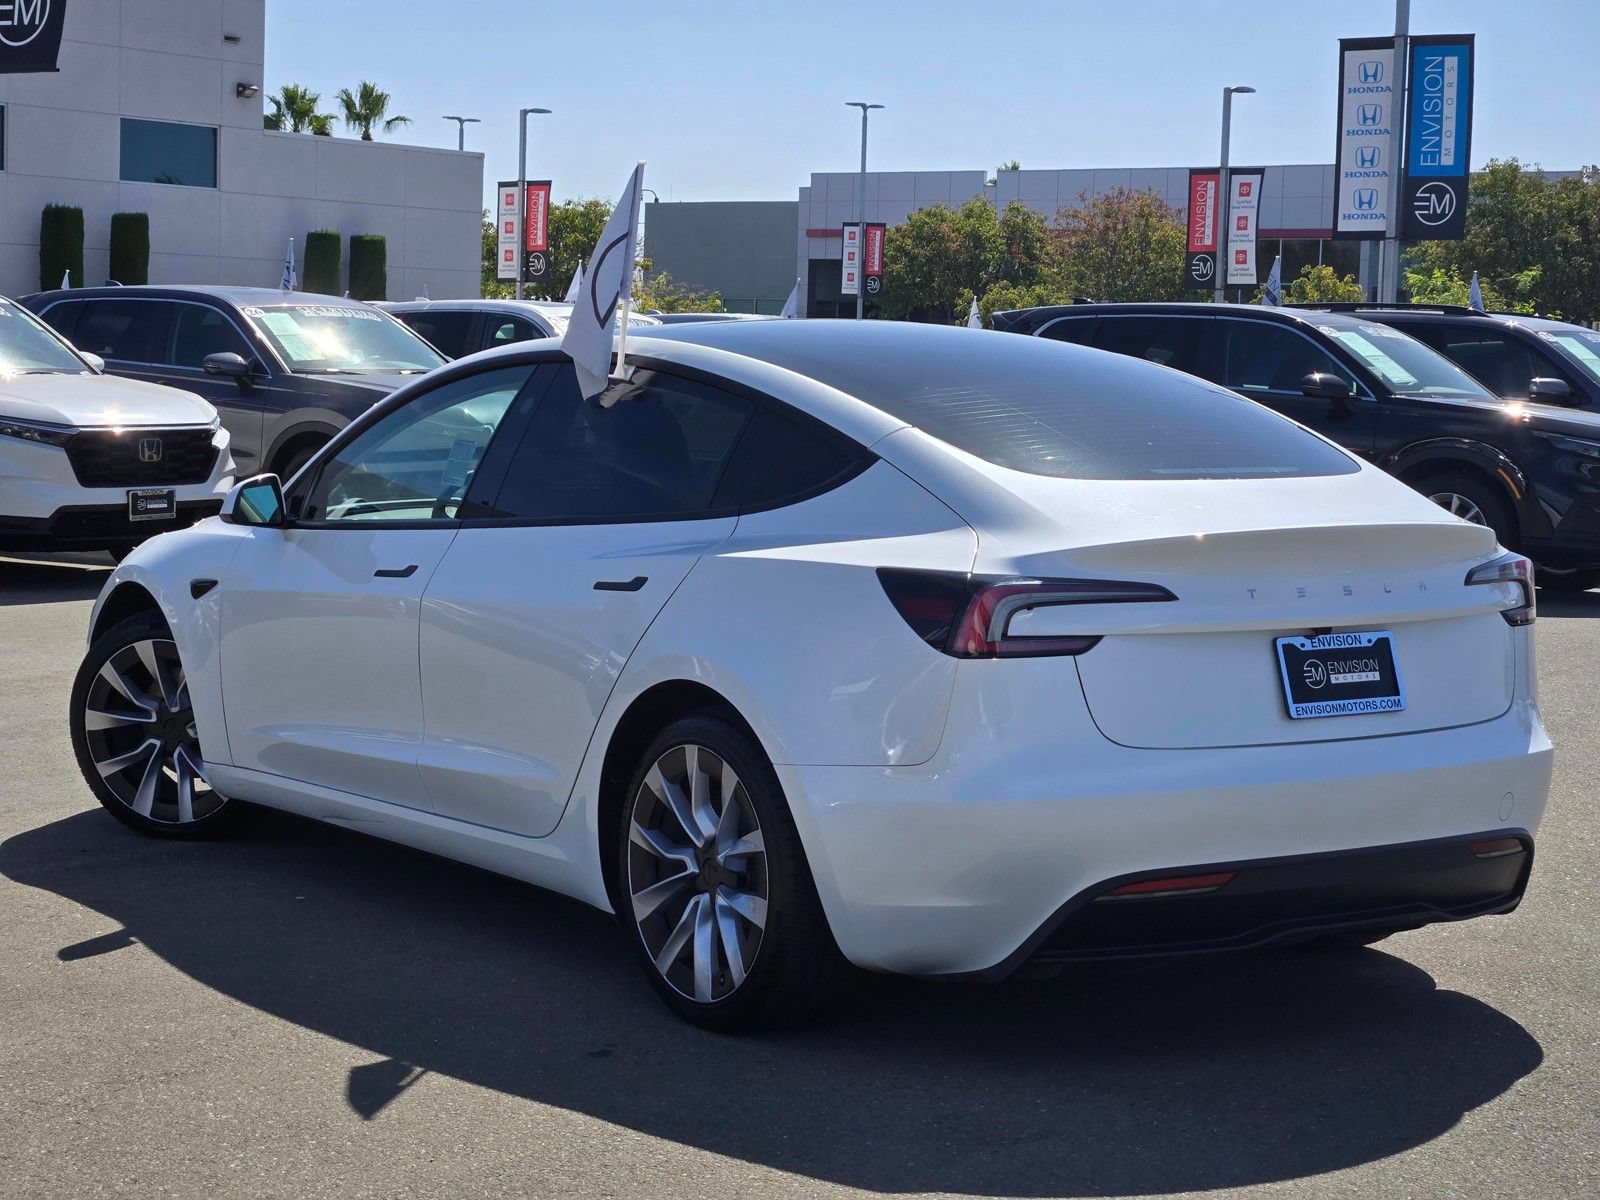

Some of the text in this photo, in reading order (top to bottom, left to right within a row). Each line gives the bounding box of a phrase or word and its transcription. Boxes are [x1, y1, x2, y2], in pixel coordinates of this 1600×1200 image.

[1347, 86, 1392, 94] HONDA
[1420, 56, 1443, 166] ENVISION
[1443, 66, 1455, 156] MOTORS
[530, 190, 540, 246] ENVISION
[1195, 181, 1207, 245] ENVISION
[1246, 580, 1428, 600] TESLA
[1310, 634, 1362, 648] ENVISION
[1327, 658, 1379, 674] ENVISION
[1295, 698, 1402, 716] ENVISIONMOTORS.COM
